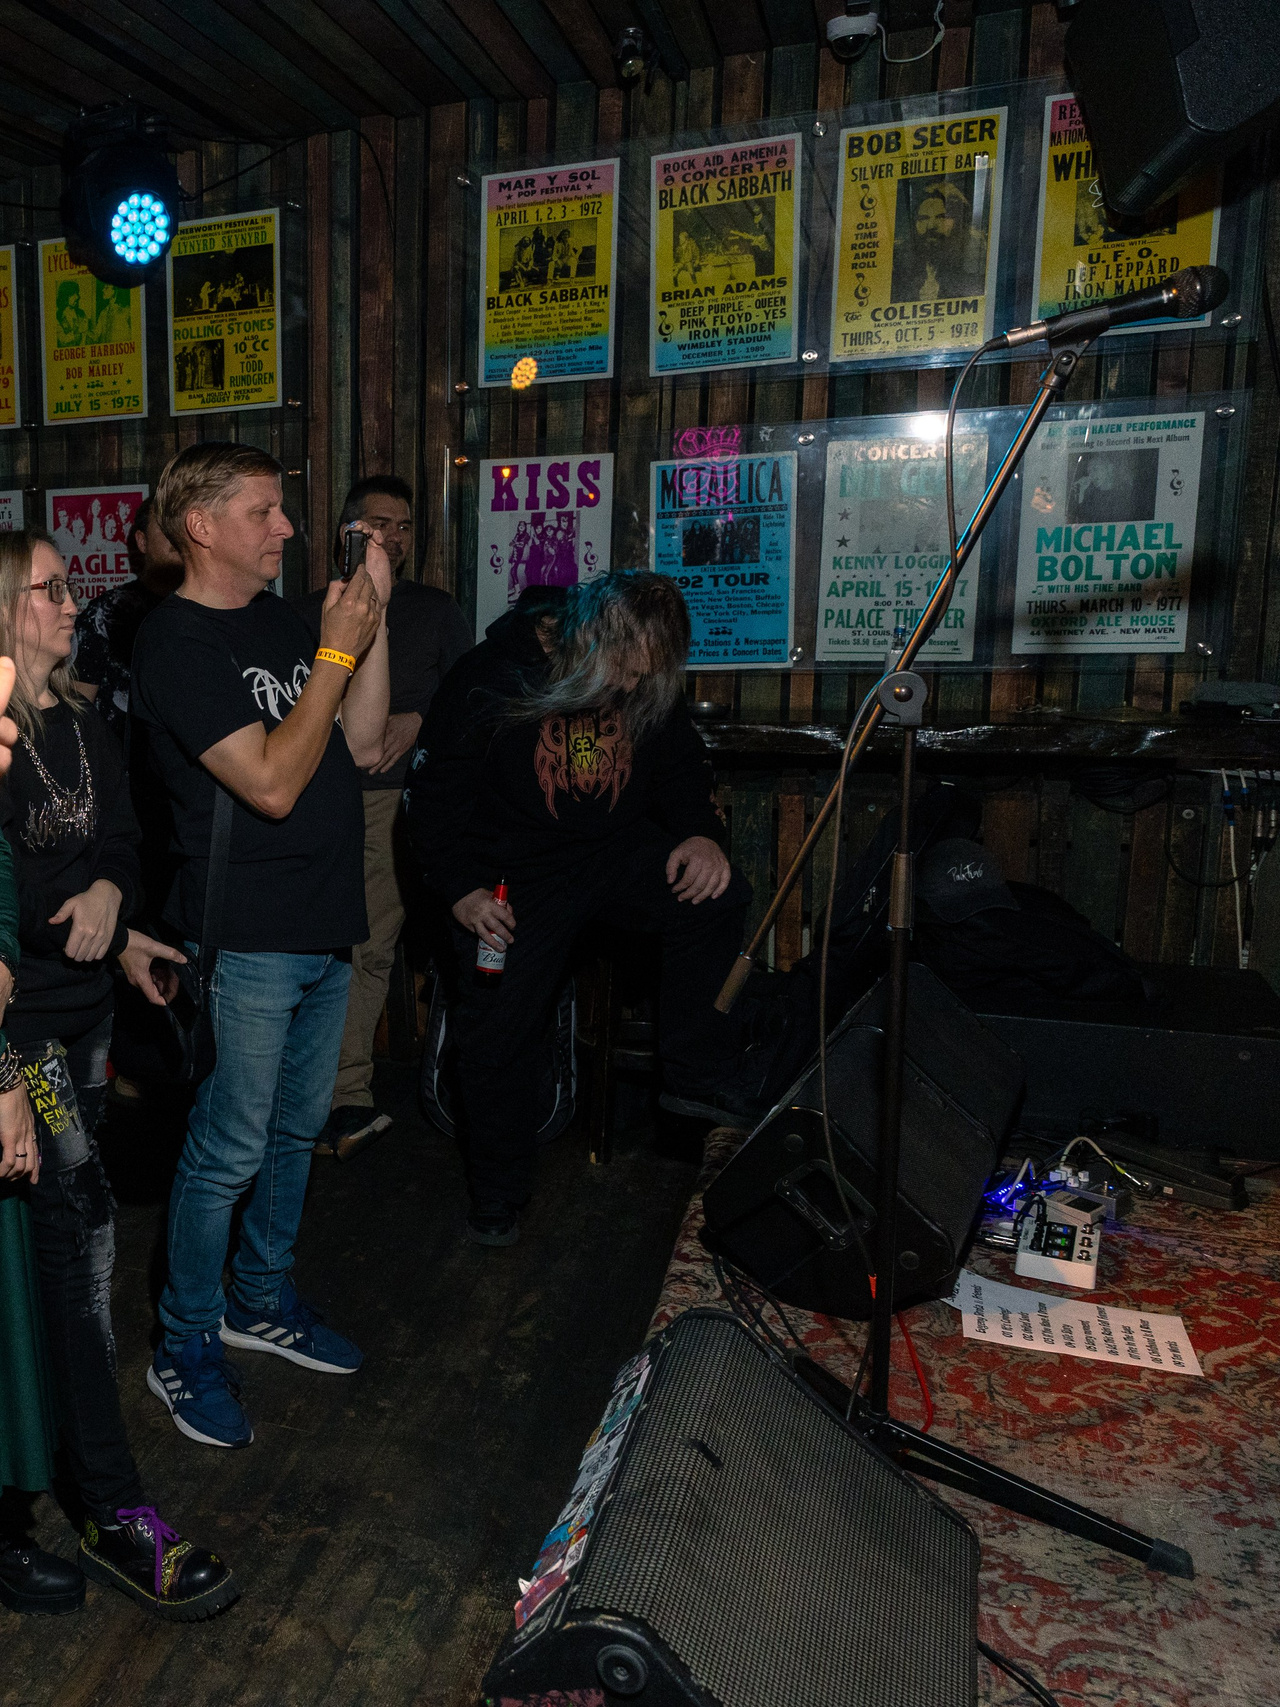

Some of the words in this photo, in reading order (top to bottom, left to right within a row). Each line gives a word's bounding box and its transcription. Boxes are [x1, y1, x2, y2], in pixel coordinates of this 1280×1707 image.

[847, 130, 902, 159] BOB
[912, 118, 997, 151] SEGER
[663, 158, 696, 174] ROCK
[703, 154, 724, 168] AID
[731, 144, 788, 163] ARMENIA
[681, 160, 769, 183] CONCERT
[850, 163, 894, 183] SILVER
[901, 156, 949, 176] BULLET
[498, 178, 536, 193] MAR
[546, 174, 558, 186] Y
[568, 169, 601, 183] SOL
[518, 189, 537, 198] POP
[540, 183, 582, 195] FESTIVAL
[658, 182, 710, 211] BLACK
[716, 169, 792, 202] SABBATH
[495, 210, 529, 227] APRIL
[560, 205, 567, 219] 3
[580, 200, 603, 217] 1972
[224, 217, 260, 230] FESTIVAL
[856, 221, 878, 231] OLD
[177, 237, 216, 254] LYNYRD
[221, 230, 267, 249] SKYNYRD
[854, 231, 878, 241] TIME
[851, 241, 880, 251] ROCK
[853, 251, 877, 261] AND
[851, 260, 878, 271] ROLL
[1104, 256, 1180, 281] LEPPARD
[486, 292, 533, 310] BLACK
[539, 284, 609, 305] SABBATH
[661, 285, 716, 303] BRIAN
[722, 276, 788, 295] ADAMS
[1063, 280, 1105, 301] IRON
[680, 306, 705, 319] DEEP
[707, 301, 744, 315] PURPLE
[754, 295, 787, 310] QUEEN
[870, 298, 979, 323] COLISEUM
[679, 316, 707, 331] PINK
[712, 312, 753, 327] FLOYD
[763, 307, 787, 321] YES
[174, 324, 223, 341] ROLLING
[227, 318, 275, 336] STONES
[688, 327, 720, 341] IRON
[725, 321, 776, 338] MAIDEN
[895, 327, 923, 342] OCT.
[927, 326, 935, 341] 5
[233, 341, 247, 354] 10
[726, 333, 772, 346] STADIUM
[53, 347, 86, 362] GEORGE
[90, 341, 136, 359] HARRISON
[681, 349, 724, 361] DECEMBER
[726, 348, 736, 356] 15
[745, 345, 765, 353] 1989
[65, 366, 83, 381] BOB
[88, 362, 124, 378] MARLEY
[239, 359, 264, 374] TODD
[229, 372, 275, 388] RUNDGREN
[233, 387, 263, 395] WEEKEND
[52, 400, 83, 415] JULY
[89, 399, 101, 411] 15
[111, 394, 140, 409] 1975
[200, 396, 231, 405] AUGUST
[1091, 423, 1122, 435] HAVEN
[1126, 418, 1197, 432] PERFORMANCE
[1132, 437, 1144, 445] His
[1165, 434, 1190, 443] Album
[490, 460, 601, 512] KISS
[660, 460, 783, 510] METALLICA
[1035, 522, 1183, 554] MICHAEL
[832, 555, 888, 570] KENNY
[1036, 552, 1178, 582] BOLTON
[708, 572, 771, 588] TOUR
[826, 580, 886, 598] APRIL
[1047, 584, 1071, 595] WITH
[1074, 583, 1090, 593] HIS
[1093, 583, 1113, 593] FINE
[1117, 582, 1142, 592] BAND
[1079, 598, 1124, 613] MARCH
[1130, 597, 1143, 612] 10
[1155, 596, 1183, 612] 1977
[823, 608, 886, 629] PALACE
[1030, 615, 1088, 628] OXFORD
[1096, 615, 1123, 627] ALE
[1129, 614, 1176, 627] HOUSE
[1044, 628, 1085, 636] WHITNEY
[1088, 628, 1109, 636] AVE.
[1119, 627, 1140, 635] NEW
[1144, 627, 1175, 635] HAVEN
[703, 639, 732, 647] Stations
[744, 638, 786, 647] Newspapers
[828, 638, 851, 646] Tickets
[872, 638, 888, 646] Each
[317, 650, 336, 660] CLUB
[698, 649, 720, 657] Prices
[732, 648, 759, 656] Concert
[762, 647, 782, 655] Dates
[971, 1284, 982, 1300] Friends
[1022, 1333, 1033, 1341] 02
[1043, 1337, 1054, 1345] 03
